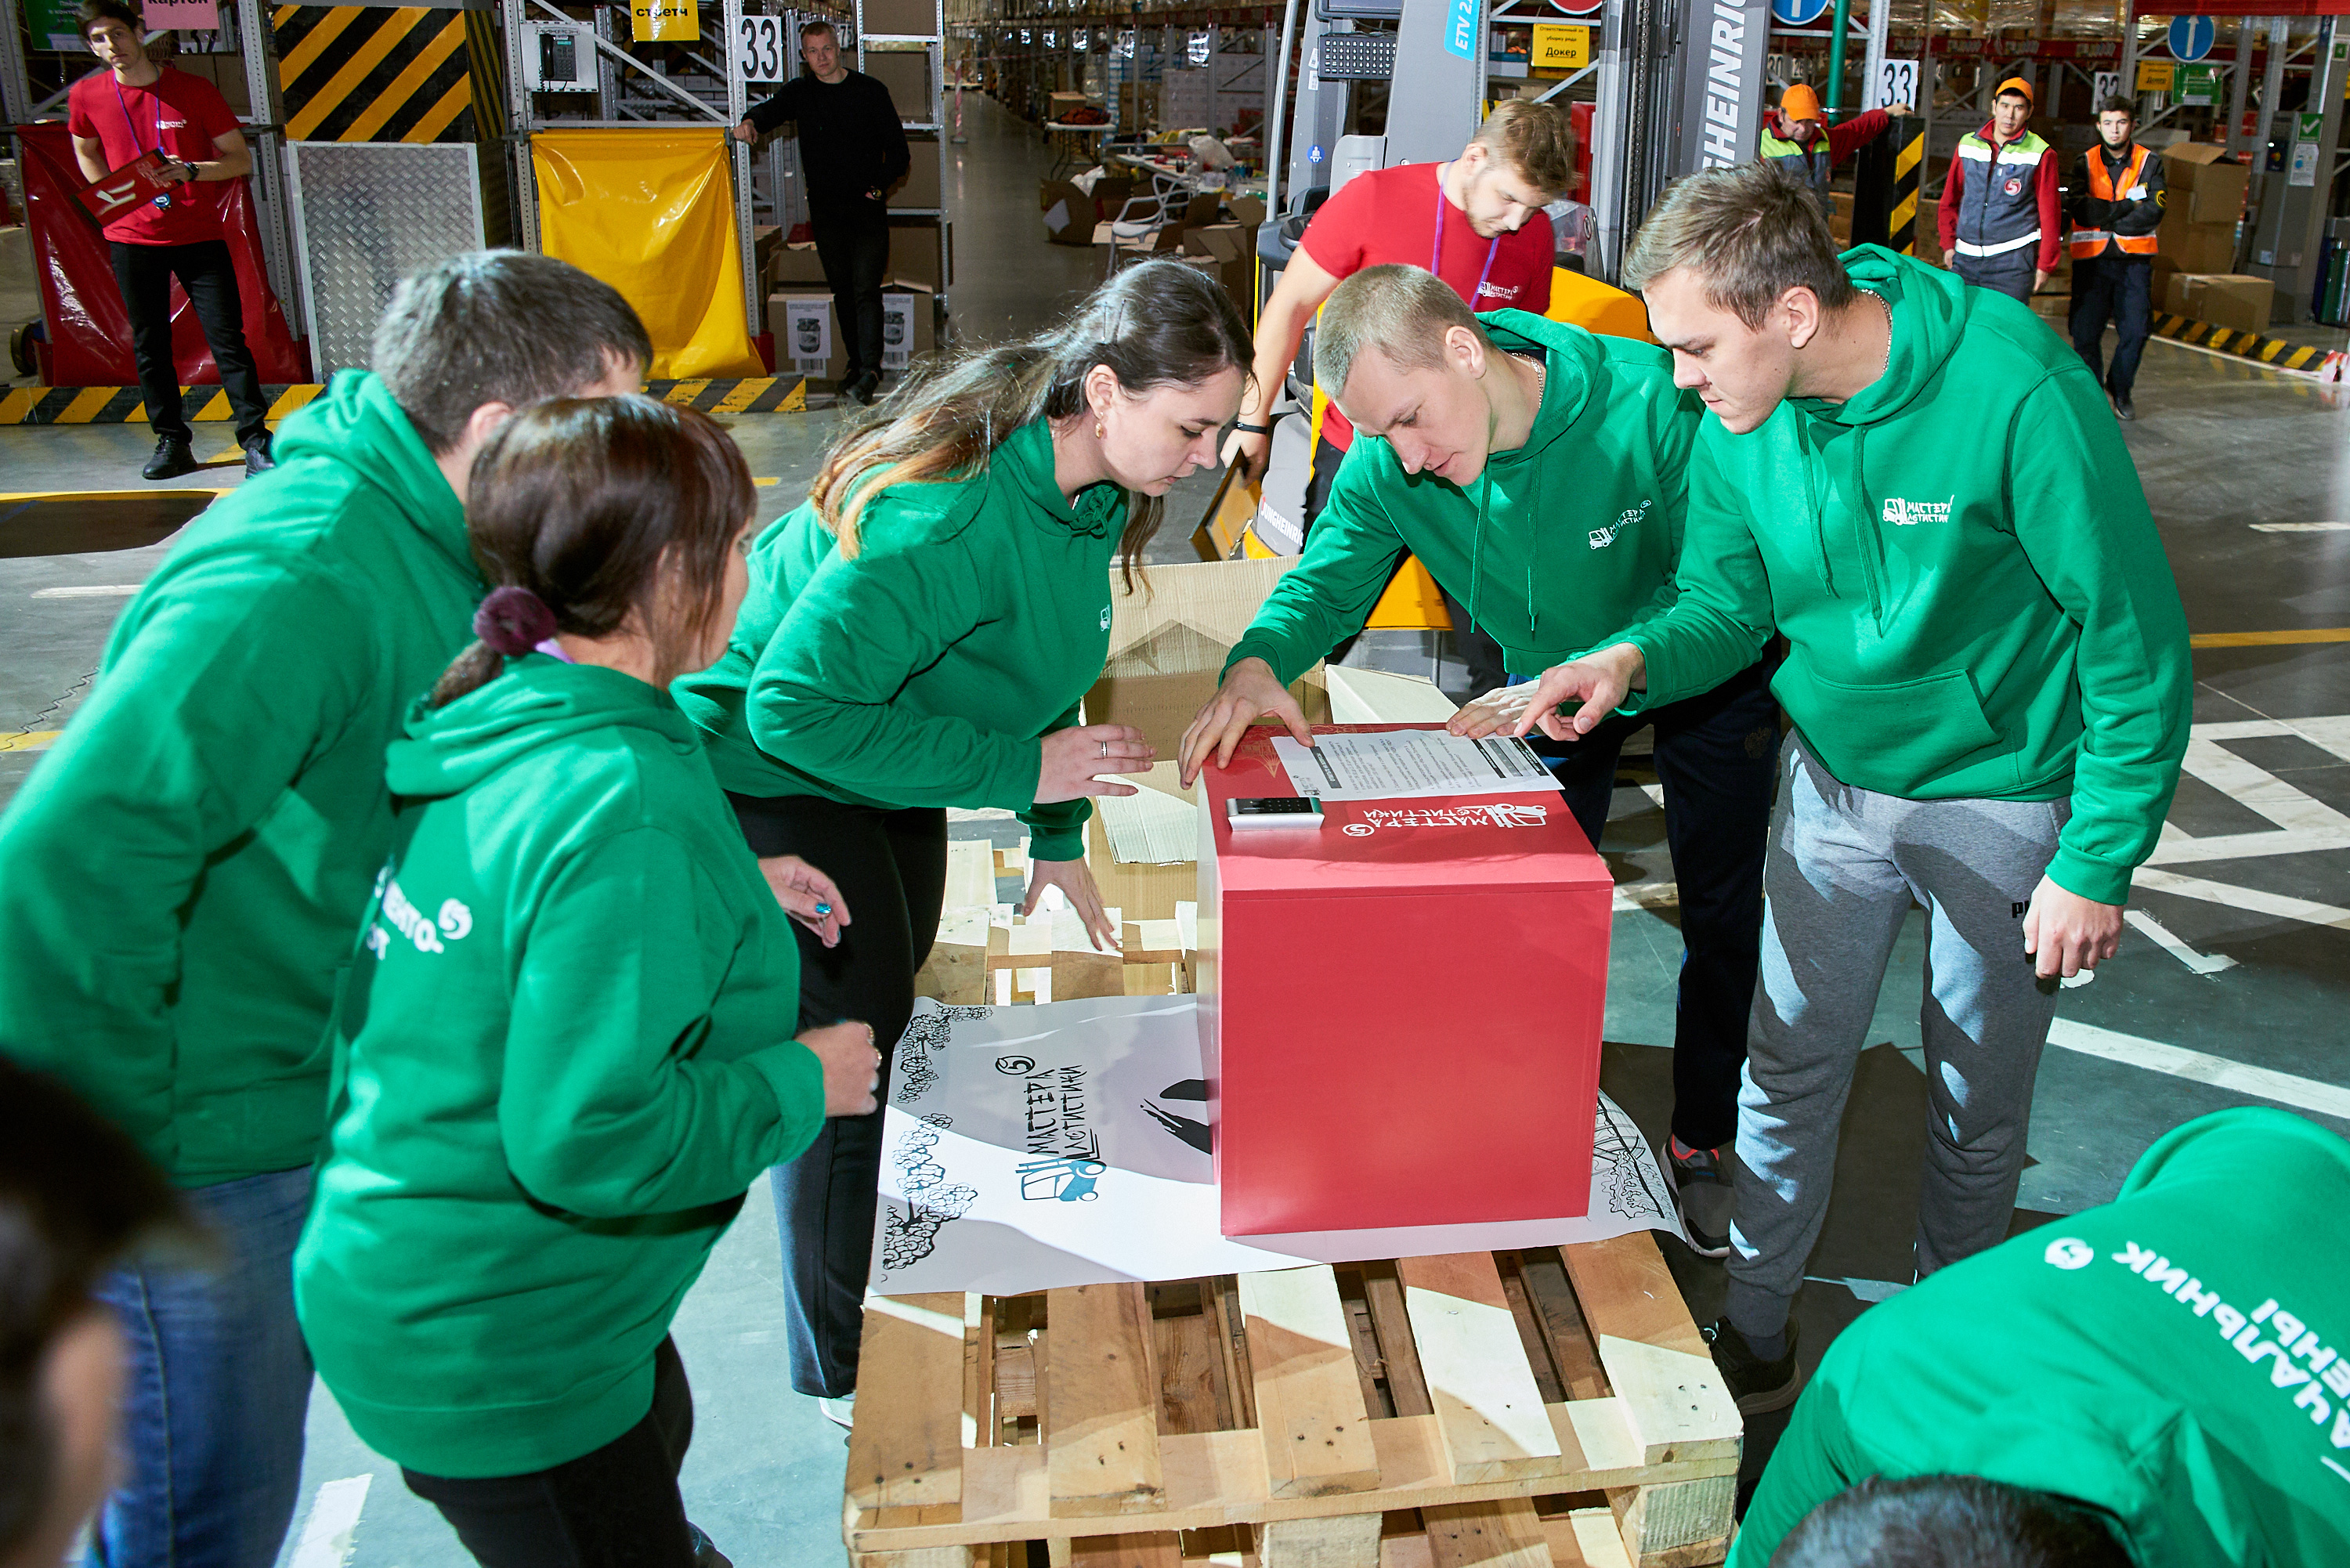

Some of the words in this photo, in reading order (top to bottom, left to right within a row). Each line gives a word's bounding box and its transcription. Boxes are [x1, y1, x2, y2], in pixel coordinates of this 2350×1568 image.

[1459, 0, 1473, 15] 2
[741, 19, 778, 78] 33
[1455, 15, 1470, 50] ETV
[1546, 47, 1577, 58] Докер
[1702, 0, 1746, 168] HEINRI
[1882, 63, 1911, 108] 33
[1370, 815, 1488, 828] МАСТЕРА
[1023, 1068, 1059, 1154] МАСТЕРА
[2251, 1298, 2350, 1410] ЕНЫ
